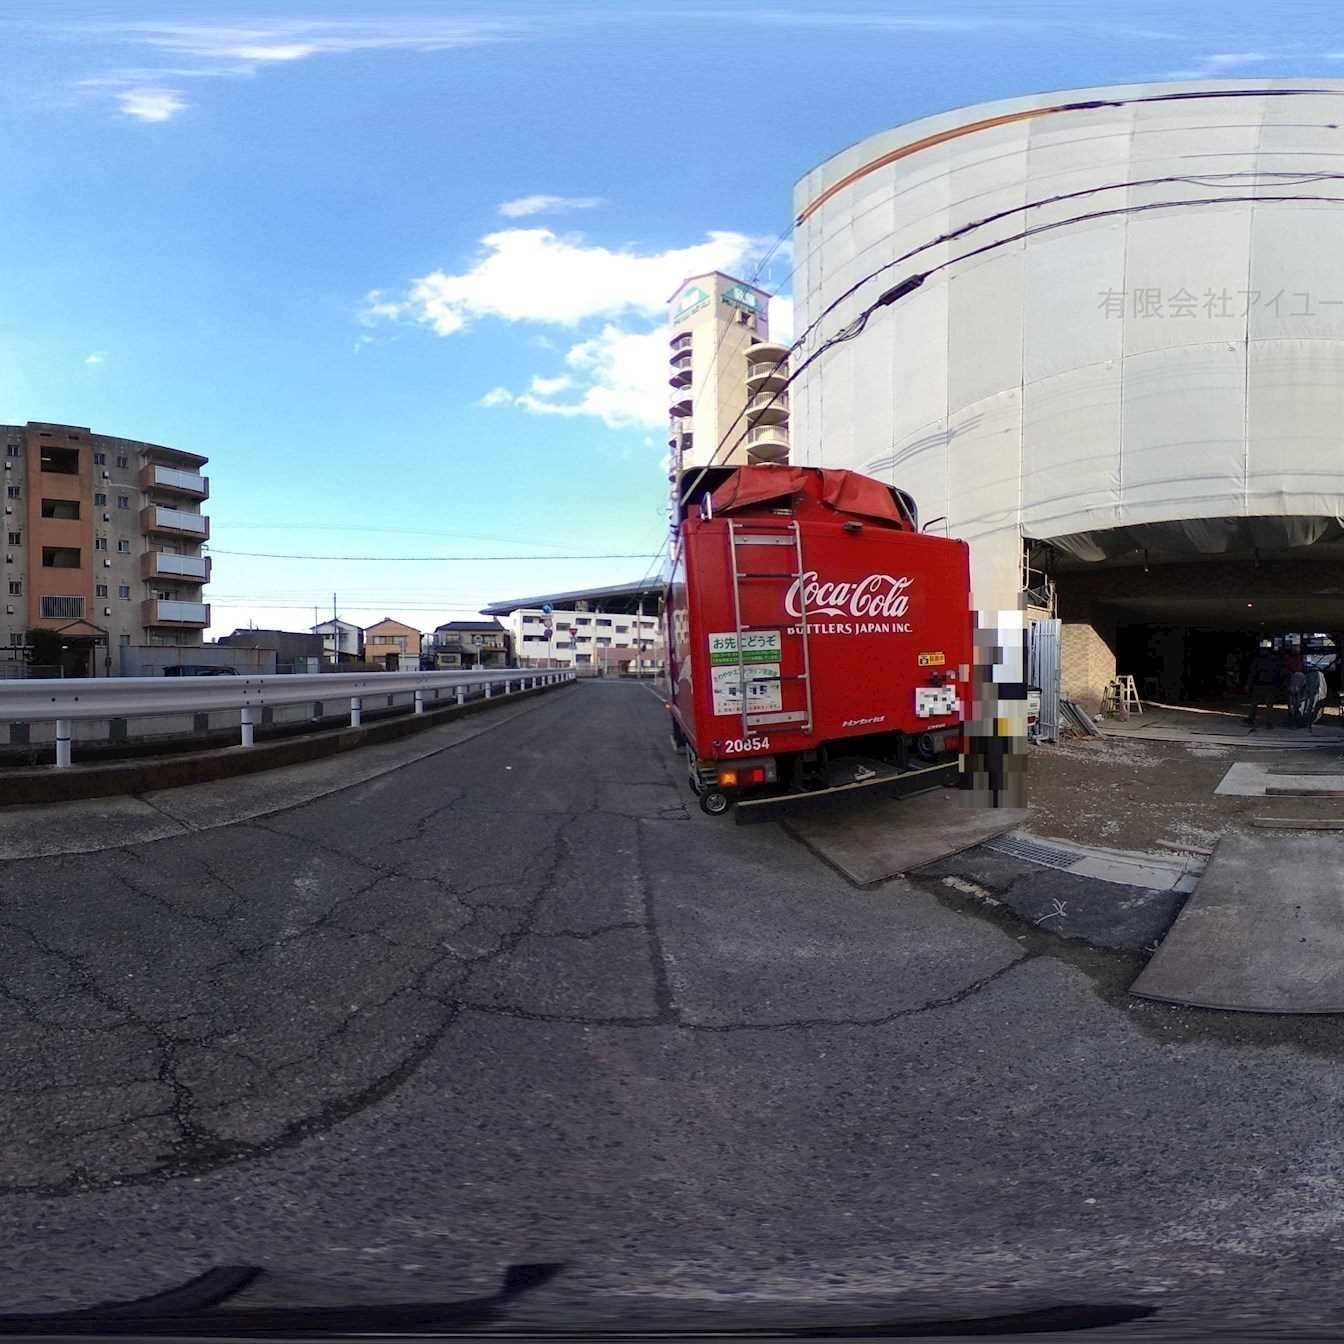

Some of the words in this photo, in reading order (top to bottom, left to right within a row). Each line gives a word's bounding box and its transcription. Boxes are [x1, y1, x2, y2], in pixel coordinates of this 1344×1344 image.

[785, 571, 915, 617] Coca-Cola
[855, 623, 890, 635] JAPAN
[725, 736, 770, 753] 20854
